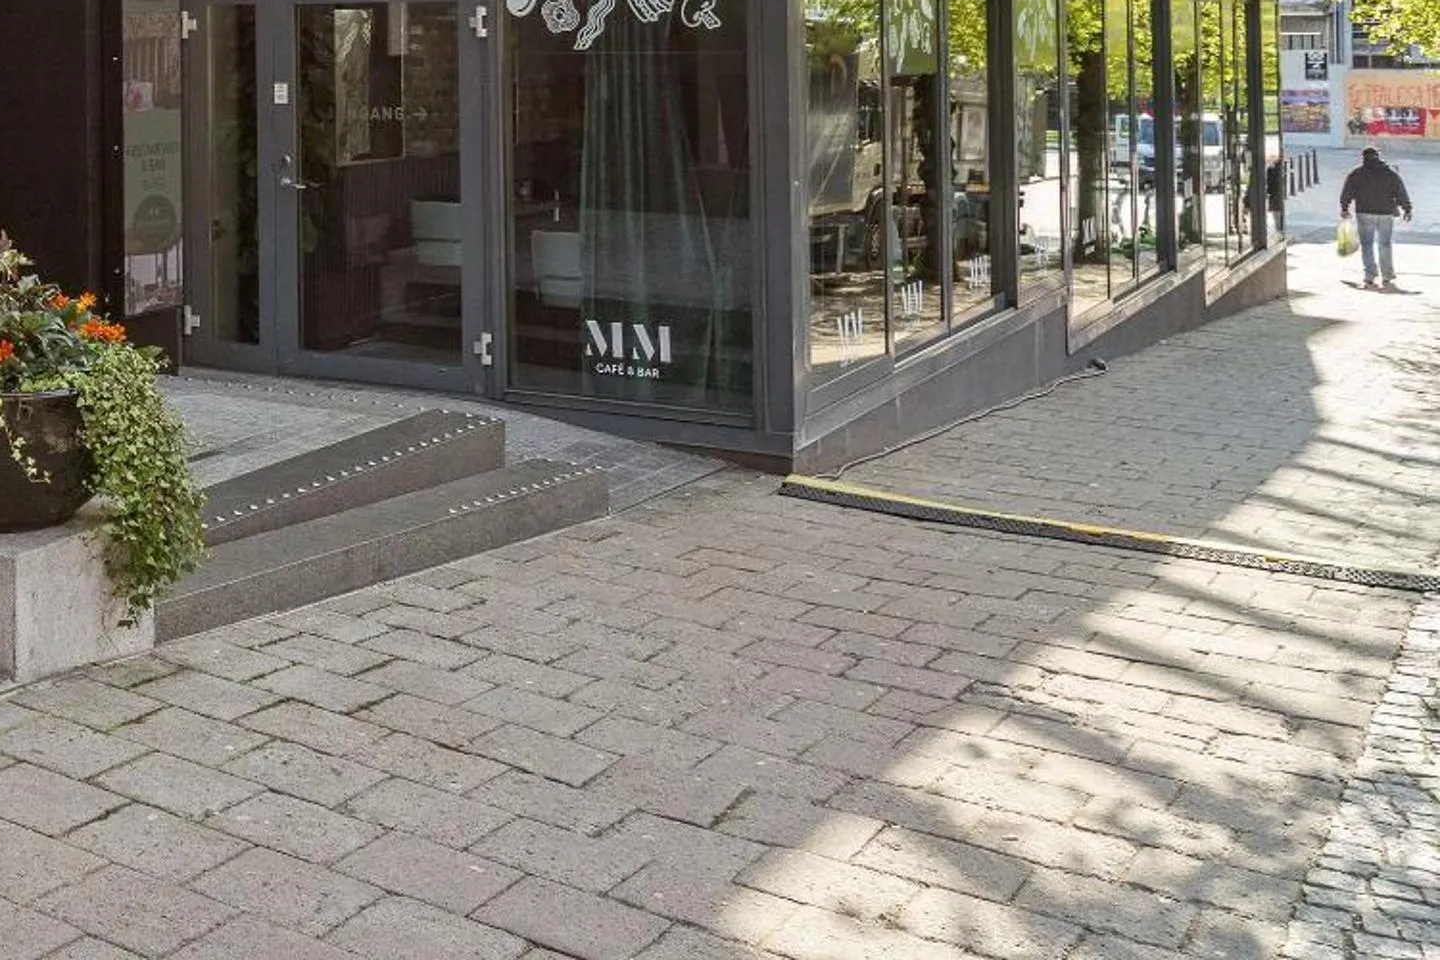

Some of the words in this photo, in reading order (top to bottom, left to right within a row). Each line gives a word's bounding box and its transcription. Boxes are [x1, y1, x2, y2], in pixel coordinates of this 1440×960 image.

[585, 319, 672, 364] MM
[596, 361, 625, 376] CAFÉ
[637, 367, 660, 379] BAR
